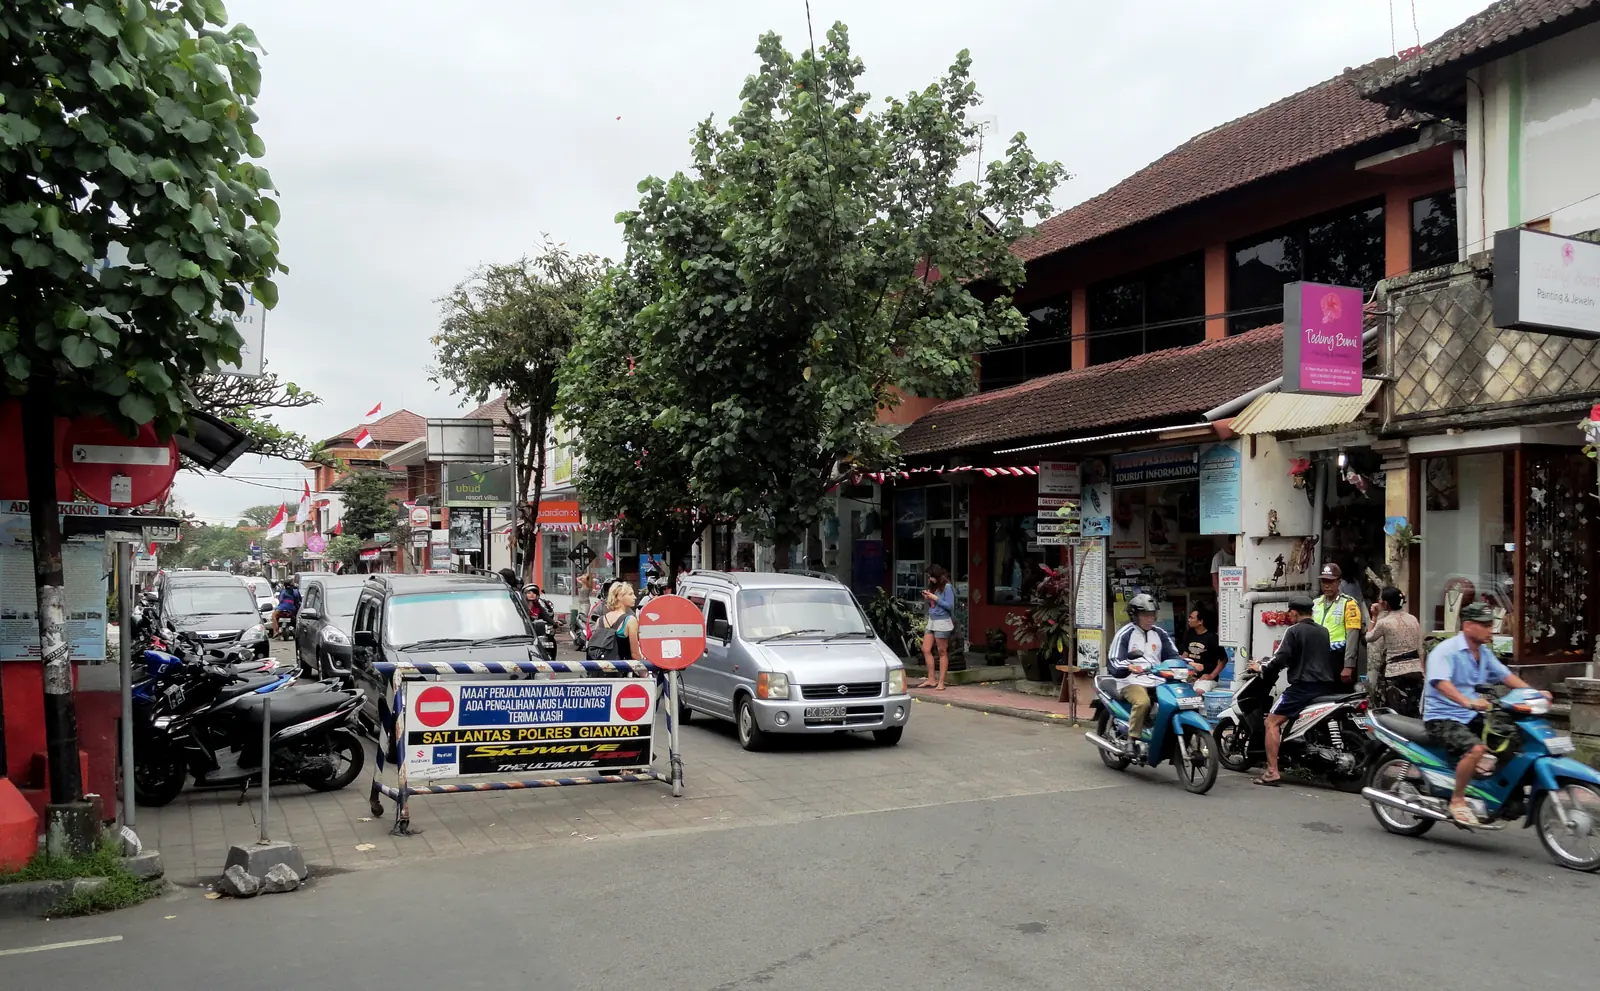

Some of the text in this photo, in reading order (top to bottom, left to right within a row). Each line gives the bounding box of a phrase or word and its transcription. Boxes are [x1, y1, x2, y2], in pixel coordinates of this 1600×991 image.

[1537, 288, 1596, 307] Painting & Jewelry
[1305, 328, 1358, 351] Tedung Bumi
[1116, 465, 1198, 482] TOURIST INFORMATION
[455, 484, 481, 493] ubud
[462, 685, 610, 699] MAAF PERJALANAN ANDA TERGANGGU
[465, 697, 606, 711] ADA PENGALIHAN ARUS LALU LINTAS
[509, 710, 563, 723] TERIMA KASIH
[806, 707, 817, 717] DK
[422, 725, 639, 744] SAT LANTAS POLRES GIANYAR
[498, 759, 600, 772] THE ULTIMATIC
